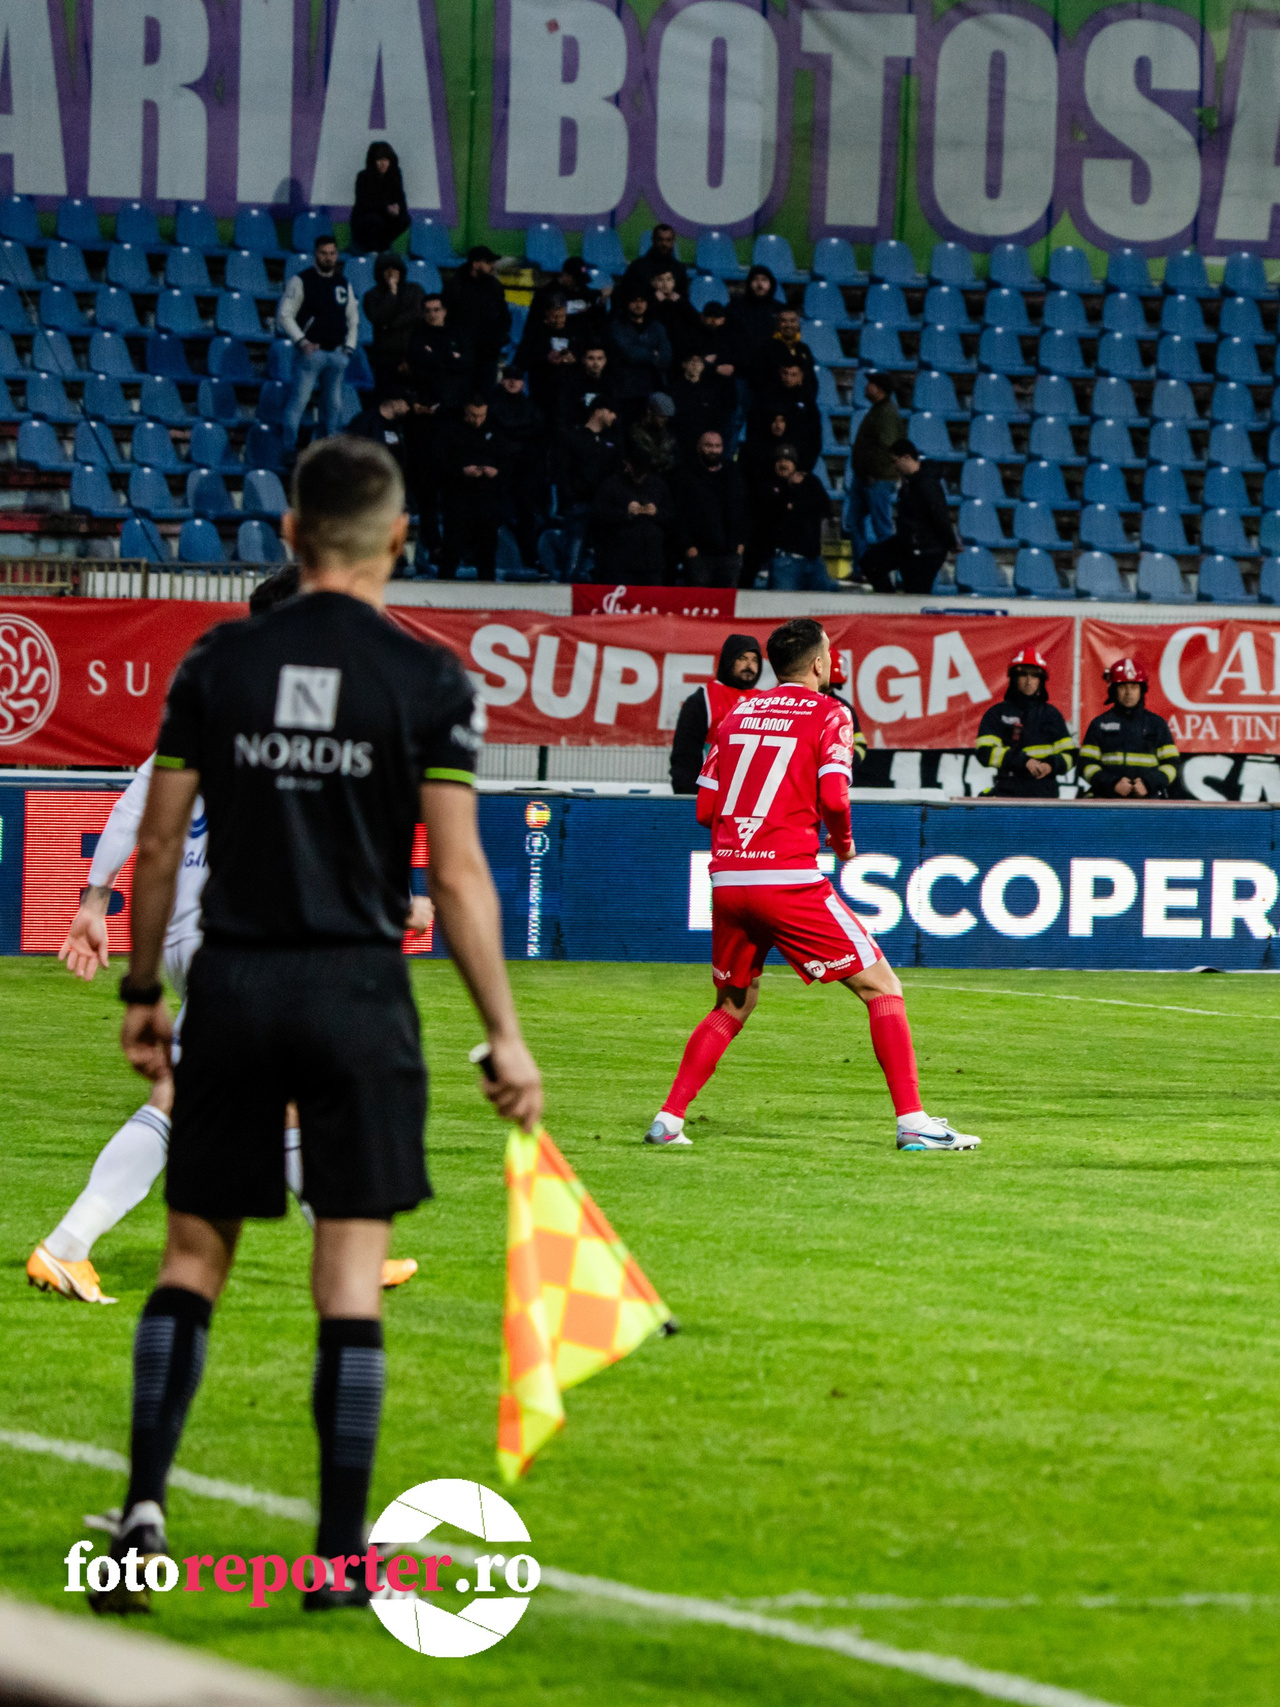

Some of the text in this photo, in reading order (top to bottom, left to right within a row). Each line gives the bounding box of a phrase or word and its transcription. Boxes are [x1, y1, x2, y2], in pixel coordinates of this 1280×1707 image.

[749, 696, 818, 709] Regata.ro
[740, 717, 794, 732] MILANOV
[234, 732, 374, 778] NORDIS
[721, 733, 798, 817] 77
[735, 850, 776, 859] GAMING
